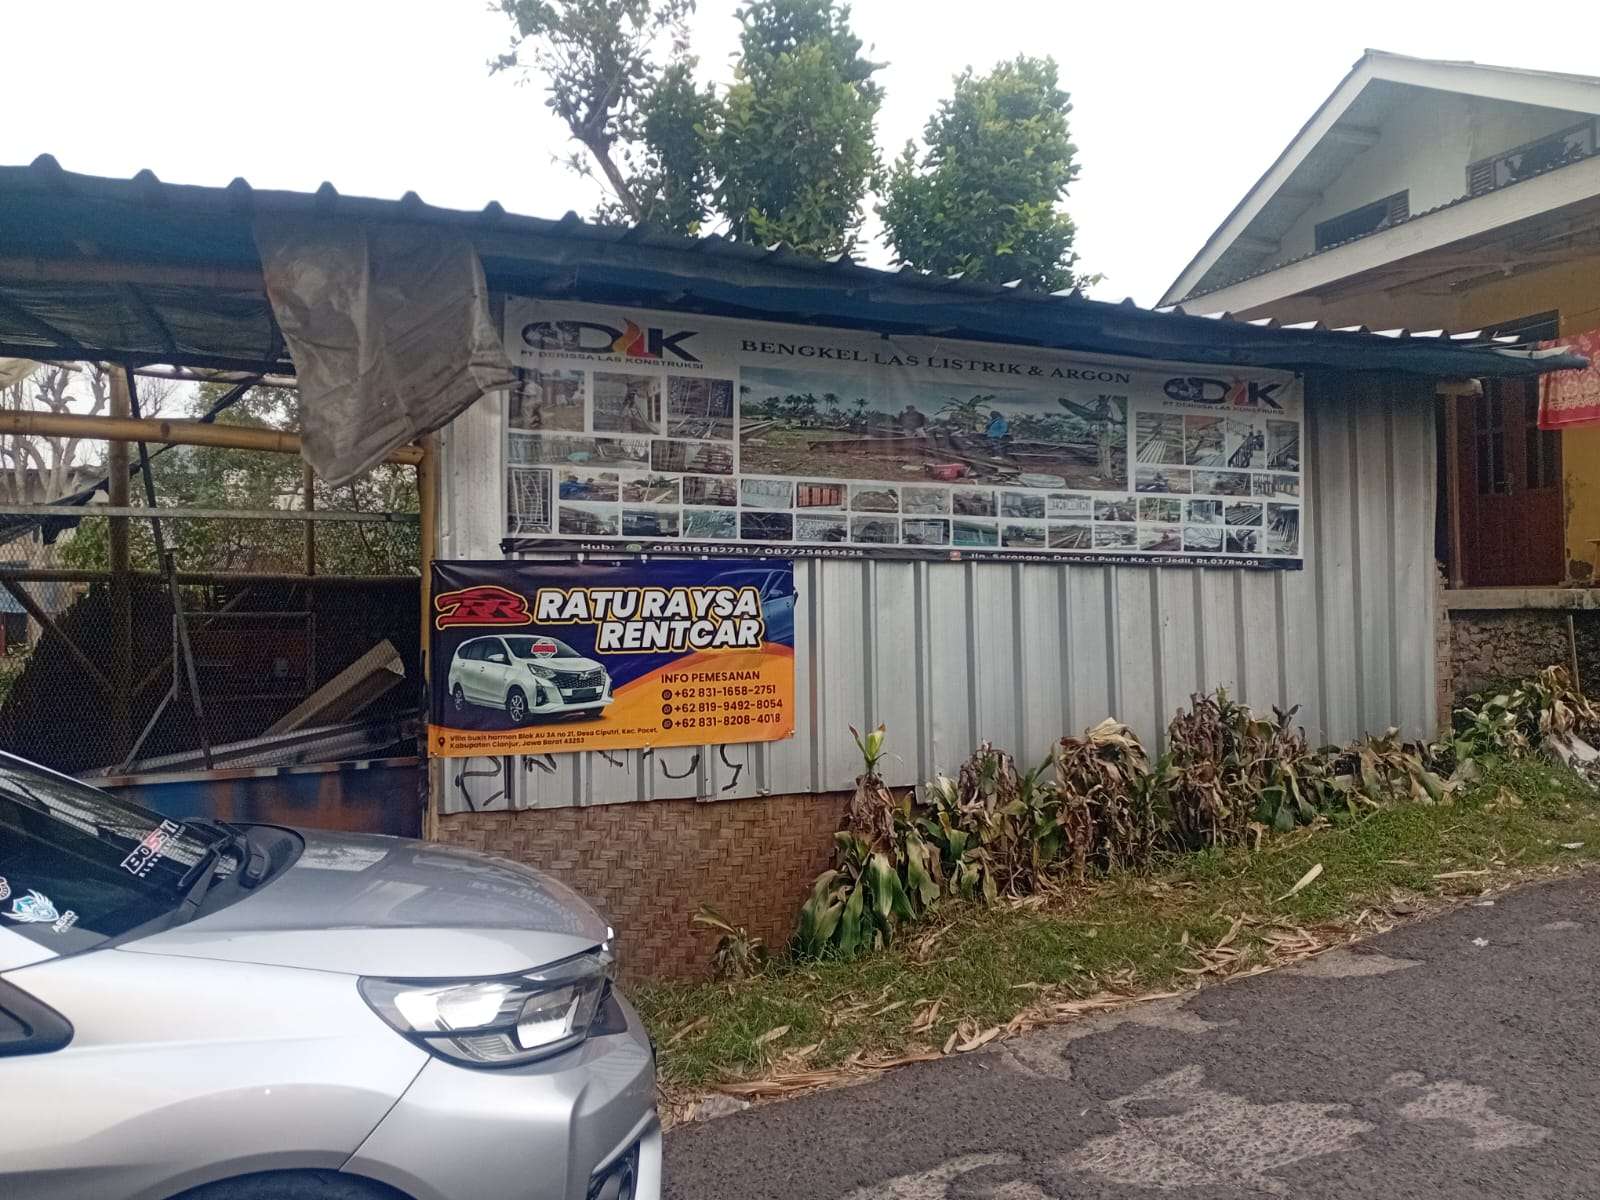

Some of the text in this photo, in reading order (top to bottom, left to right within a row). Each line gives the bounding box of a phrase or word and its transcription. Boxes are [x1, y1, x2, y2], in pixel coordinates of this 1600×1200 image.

[538, 351, 595, 361] DERISSA
[598, 355, 622, 363] LAS
[626, 357, 704, 370] KONSTRUKSI
[741, 339, 1130, 385] BENGKEL LAS LISTRIK & ARGON
[580, 543, 615, 551] Hub:
[536, 589, 761, 621] RATU RAYSA
[598, 617, 763, 650] RENTCAR
[661, 671, 760, 684] INFO PEMESANAN
[674, 684, 776, 698] +62 831-1658-2751
[674, 699, 783, 713] +62 819-9492-8054
[674, 713, 781, 728] +62 831-8208-4018
